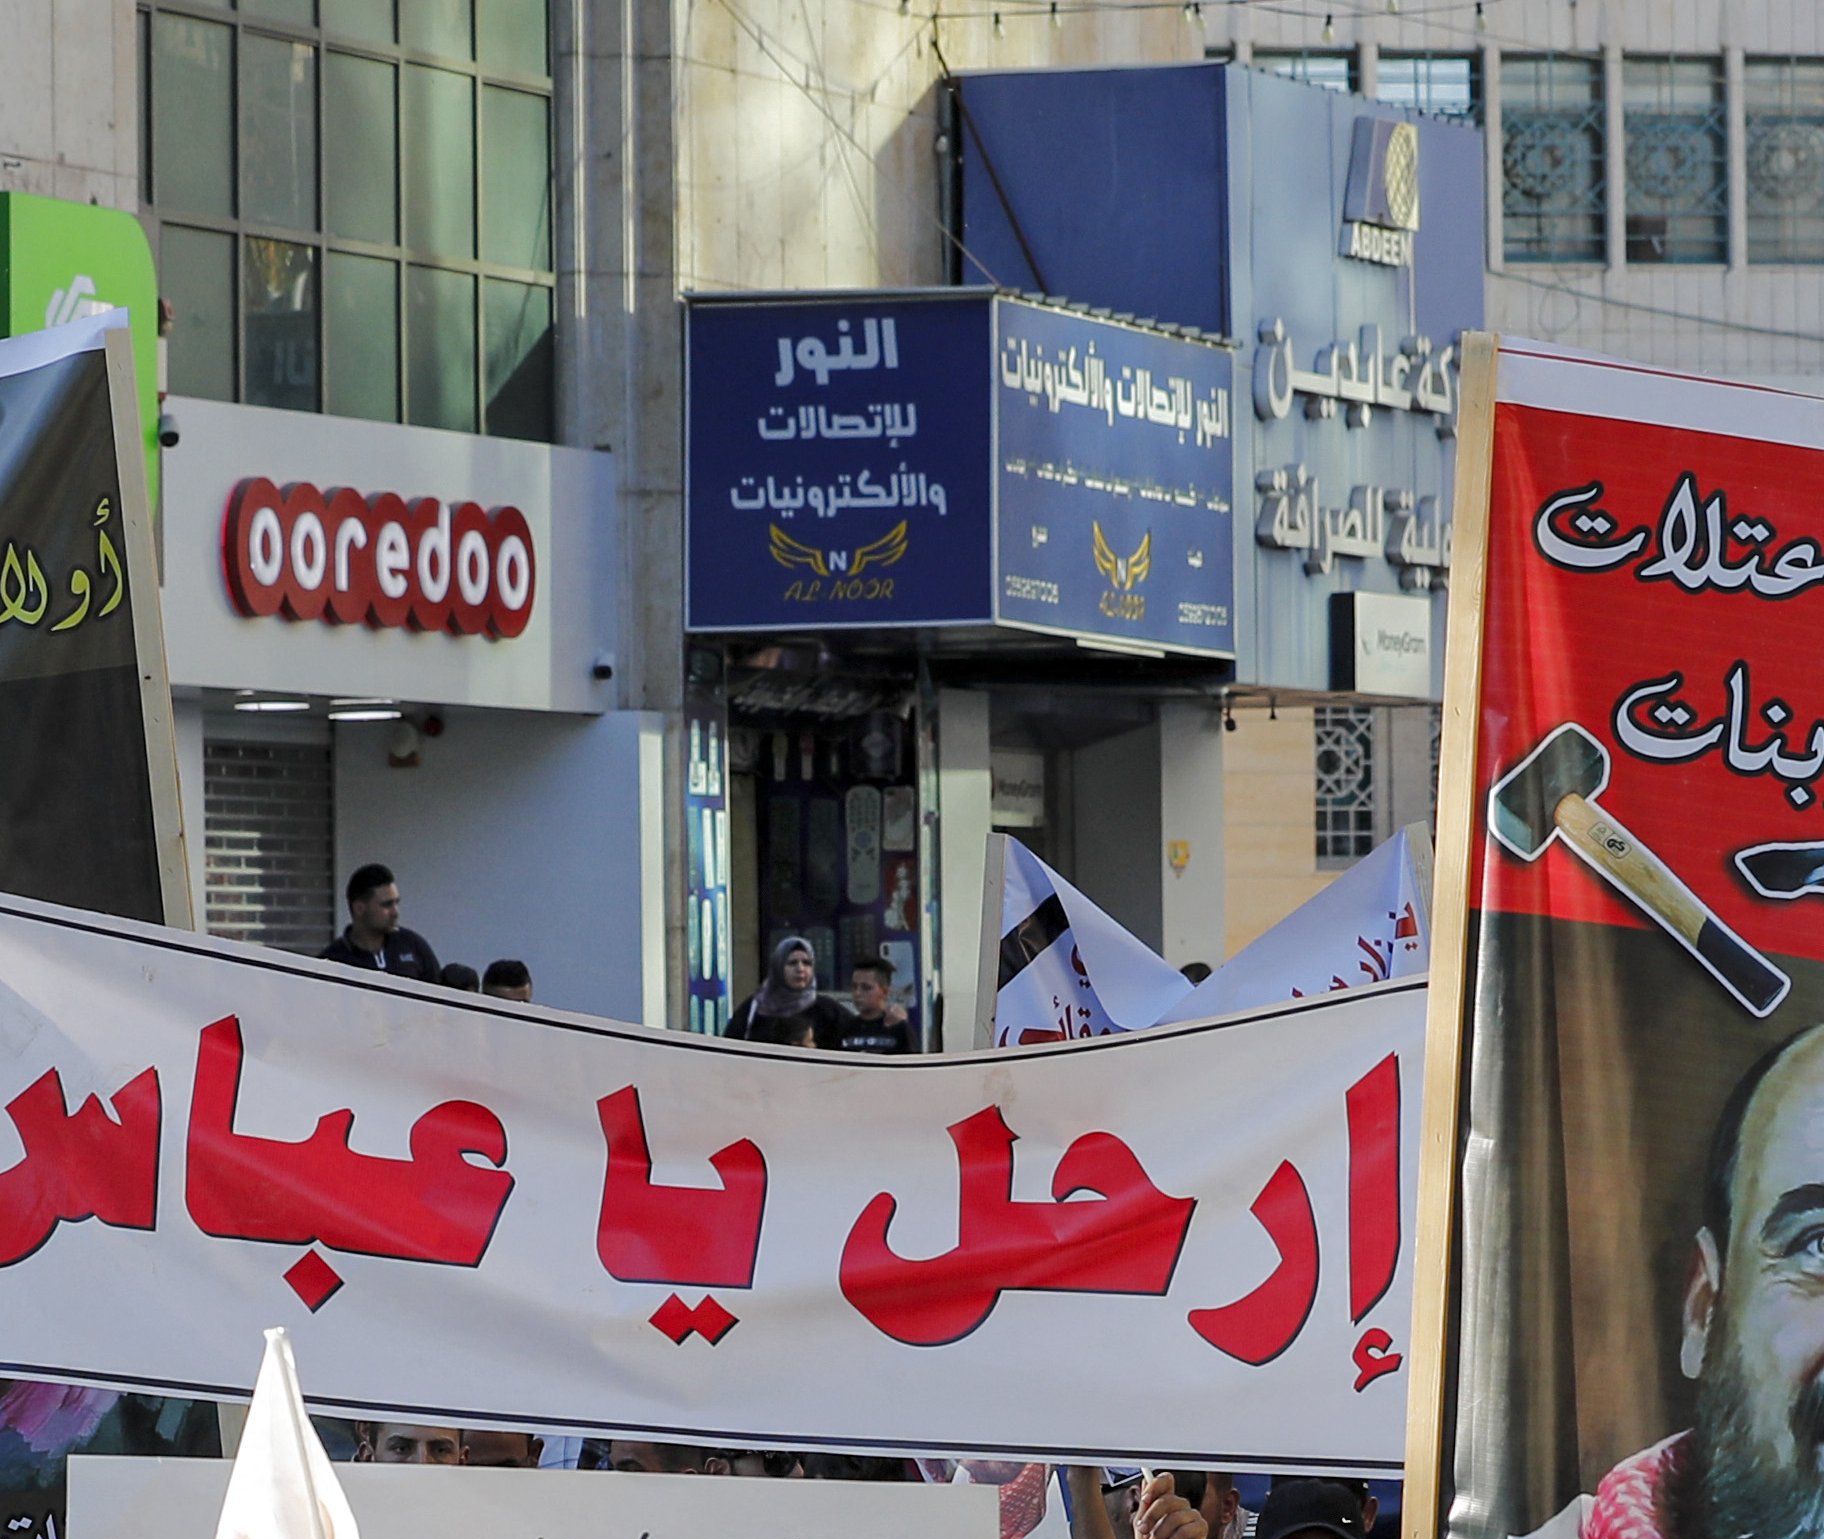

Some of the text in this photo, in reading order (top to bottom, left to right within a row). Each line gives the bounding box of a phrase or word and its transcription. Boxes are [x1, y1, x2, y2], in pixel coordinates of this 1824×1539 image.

[775, 318, 899, 387] النور
[1262, 318, 1413, 428] عابدين
[1196, 387, 1230, 449] النور
[248, 502, 530, 612] ooredoo
[829, 551, 847, 571] N
[596, 1084, 768, 1347] يا
[840, 1052, 1402, 1392] إرحل
